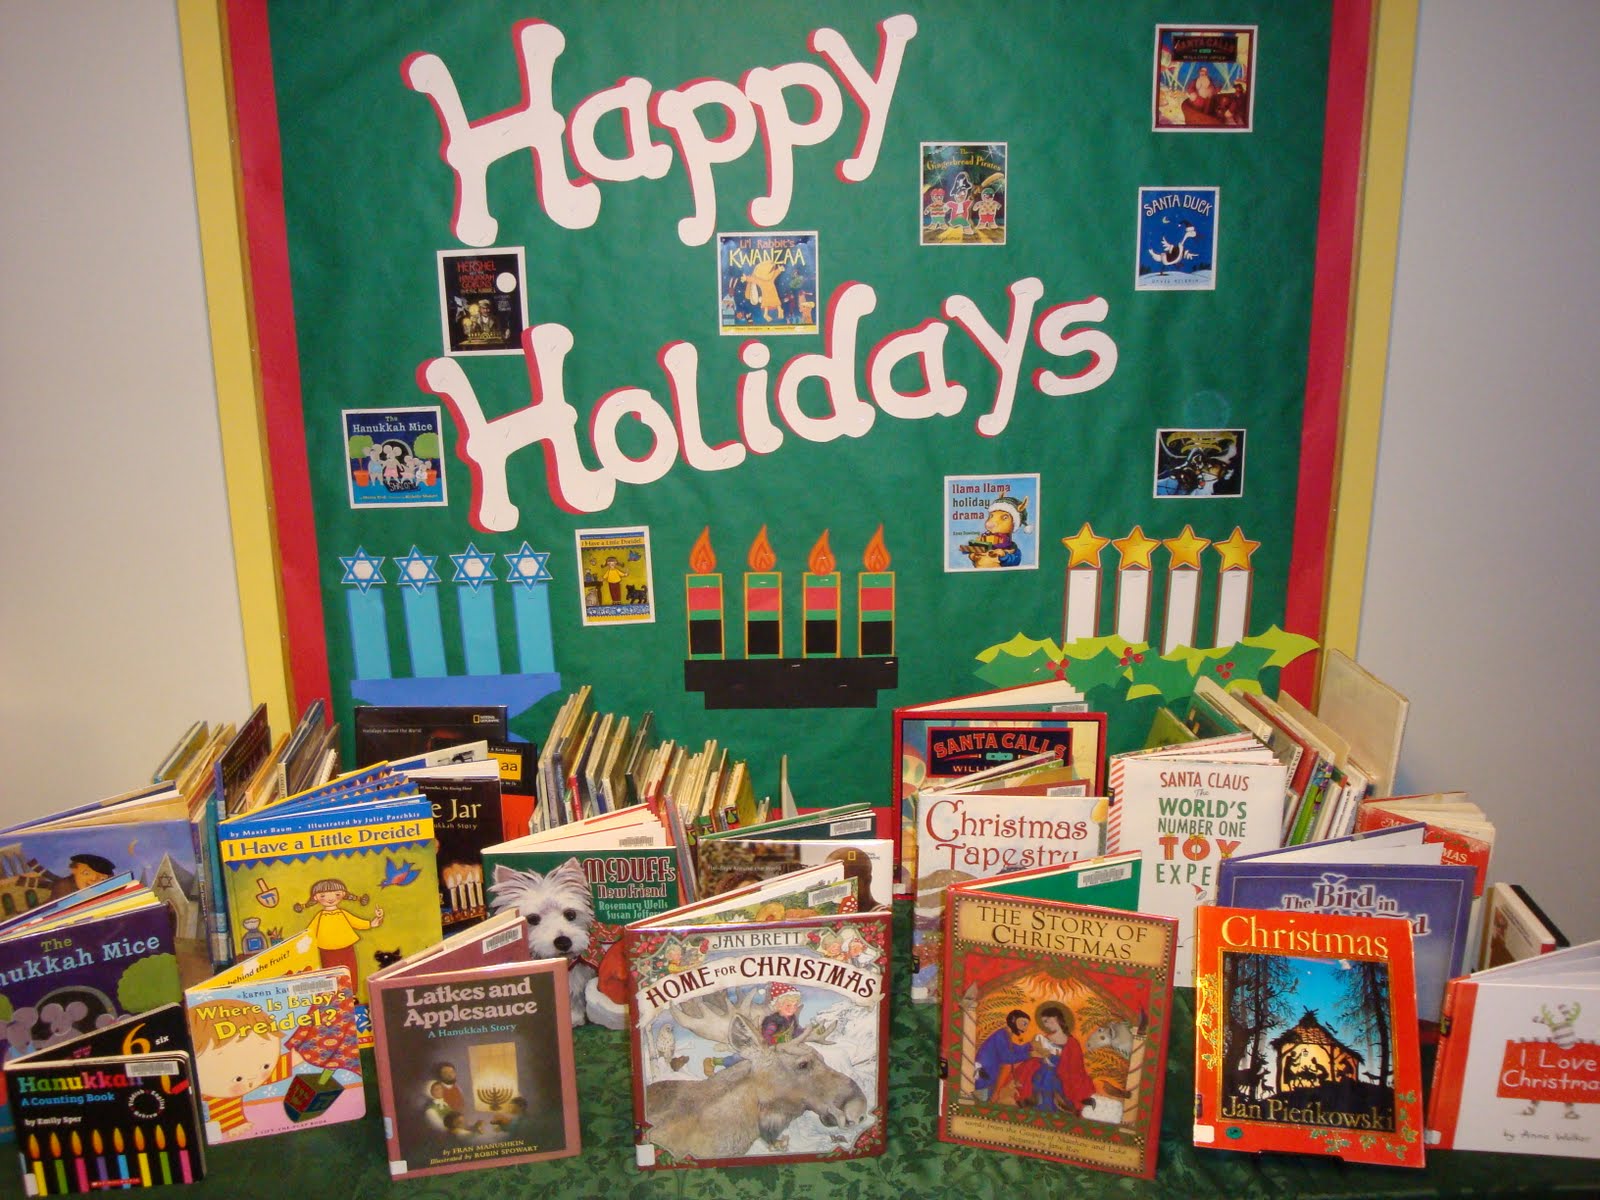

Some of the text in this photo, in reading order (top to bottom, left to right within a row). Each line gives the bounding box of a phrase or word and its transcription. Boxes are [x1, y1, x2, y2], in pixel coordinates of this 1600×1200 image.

[403, 14, 918, 247] Happy
[926, 155, 1002, 171] Gingerbread Pirates
[1143, 194, 1213, 217] SANTA DUCK
[757, 238, 796, 249] Rabbit's
[729, 247, 806, 269] KWANZAA
[415, 277, 1118, 532] Holidays
[352, 422, 433, 433] Hanukkah Mice
[952, 483, 1011, 494] llama llama
[952, 497, 991, 510] holiday
[952, 511, 985, 520] drama
[933, 733, 1067, 760] SANTA CALLS
[952, 765, 996, 773] WILLI
[1159, 771, 1250, 791] SANTA CLAUS
[1194, 788, 1210, 797] The
[447, 798, 482, 823] Jar
[1158, 797, 1247, 820] WORLD'S
[230, 830, 240, 838] by
[242, 828, 268, 837] Maxie
[270, 825, 293, 834] Baum
[308, 820, 350, 830] Illustrated
[352, 817, 362, 825] by
[365, 815, 384, 824] Julie
[386, 811, 421, 822] Paschkis
[925, 799, 1088, 843] Christmas
[1157, 818, 1246, 838] NUMBER ONE
[228, 823, 421, 857] I Have a Little Dreidel
[1158, 834, 1242, 861] TOY
[598, 899, 668, 911] Rosemary Wells
[1283, 884, 1396, 911] The Bird in
[606, 909, 661, 919] Susan Jeffer
[977, 905, 1148, 943] THE STORY OF
[40, 938, 73, 953] The
[712, 932, 802, 949] JAN BRETT
[991, 924, 1132, 960] CHRISTMAS
[1220, 915, 1389, 958] Christmas
[102, 936, 161, 962] Mice
[255, 961, 269, 974] the
[269, 950, 291, 966] fruit?
[242, 988, 272, 999] karen
[405, 977, 532, 1007] Latkes and
[645, 956, 877, 1009] HOME FOR CHRISTMAS
[196, 991, 346, 1021] Where Is Baby's
[403, 1001, 538, 1029] Applesauce
[213, 1007, 338, 1040] Dreidel?
[428, 1023, 518, 1039] A Hanukkah Story
[122, 1023, 170, 1055] 6 six
[1519, 1048, 1598, 1072] I Love
[21, 1092, 116, 1107] A Counting Book
[24, 1116, 82, 1127] by Emily Sper
[1222, 1095, 1394, 1131] Jan Pieńkowski
[452, 1146, 474, 1154] FRAN
[475, 1139, 524, 1151] MANUSHKIN
[474, 1150, 499, 1159] ROBIN
[501, 1145, 539, 1155] SPOWART
